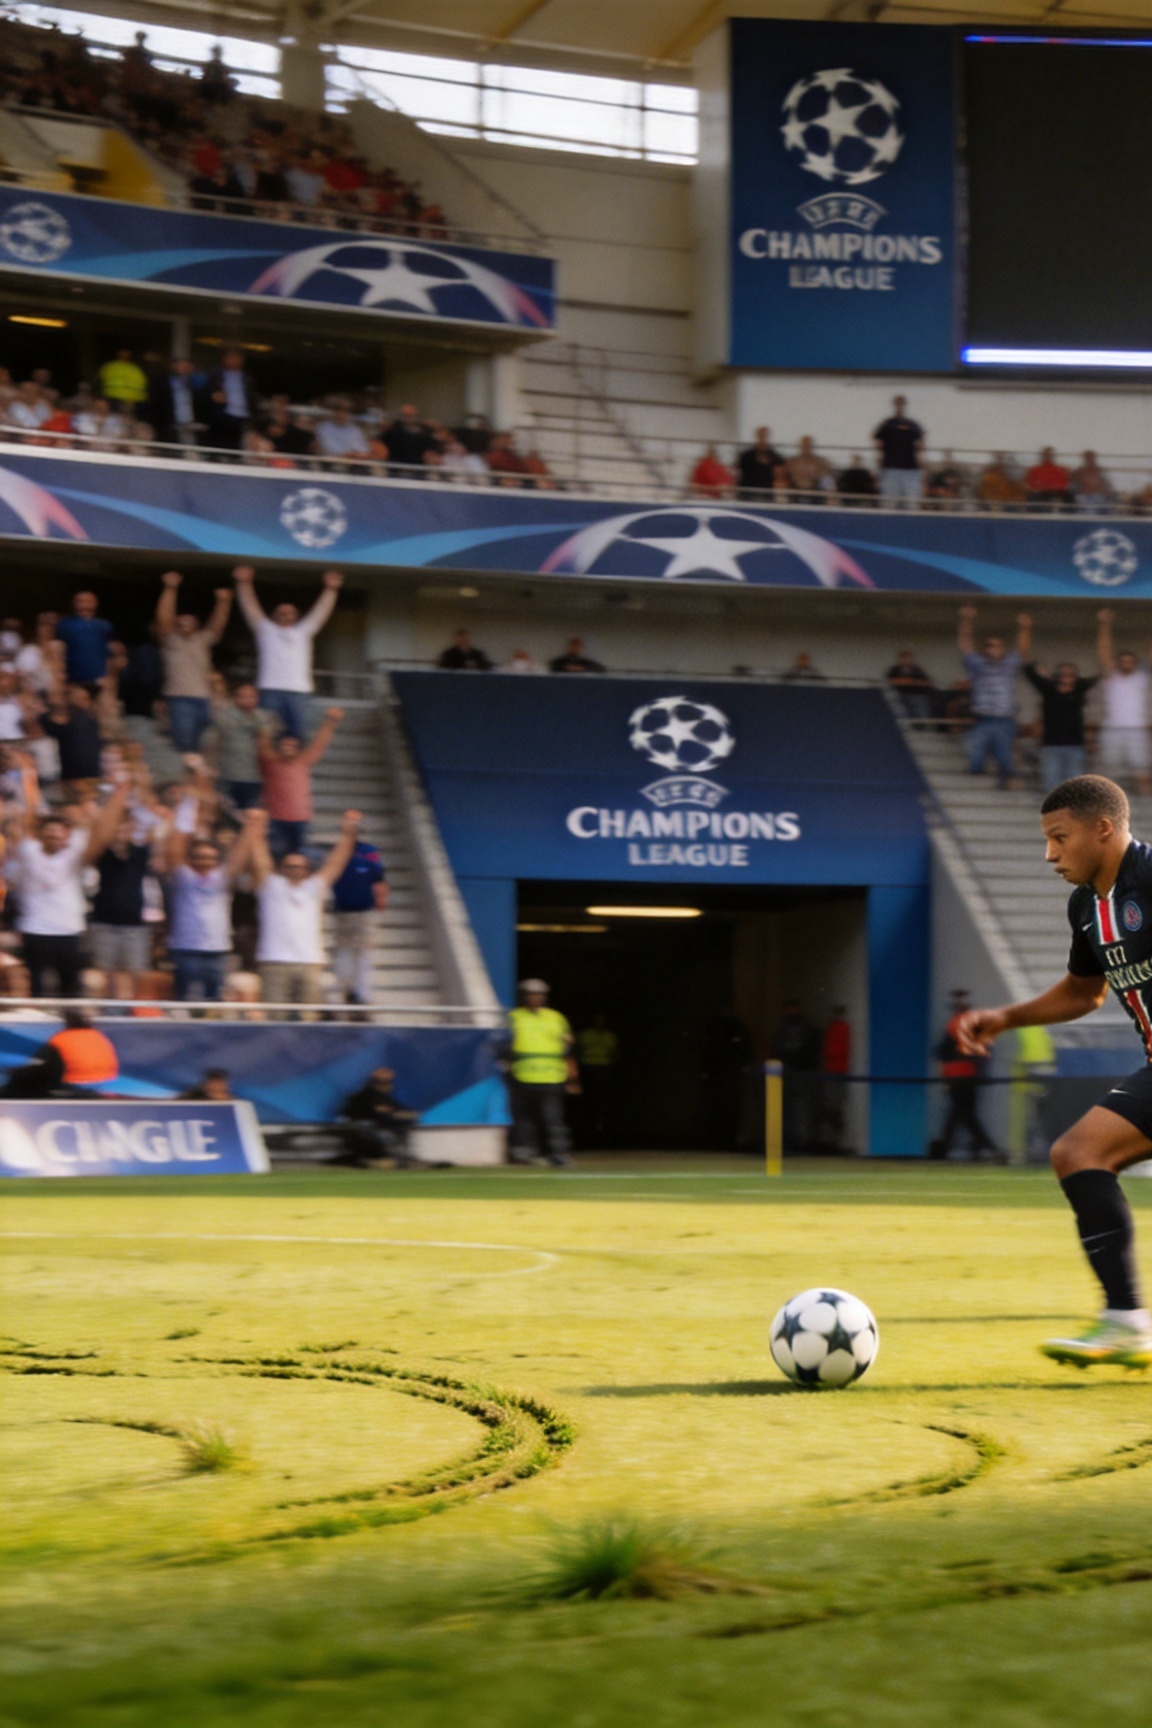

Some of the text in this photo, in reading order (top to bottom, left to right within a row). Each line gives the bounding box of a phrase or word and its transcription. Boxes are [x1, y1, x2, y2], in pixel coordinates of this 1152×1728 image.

[739, 228, 943, 264] CHAMPIONS
[566, 806, 801, 841] CHAMPIONS
[629, 843, 749, 866] LEAGUE
